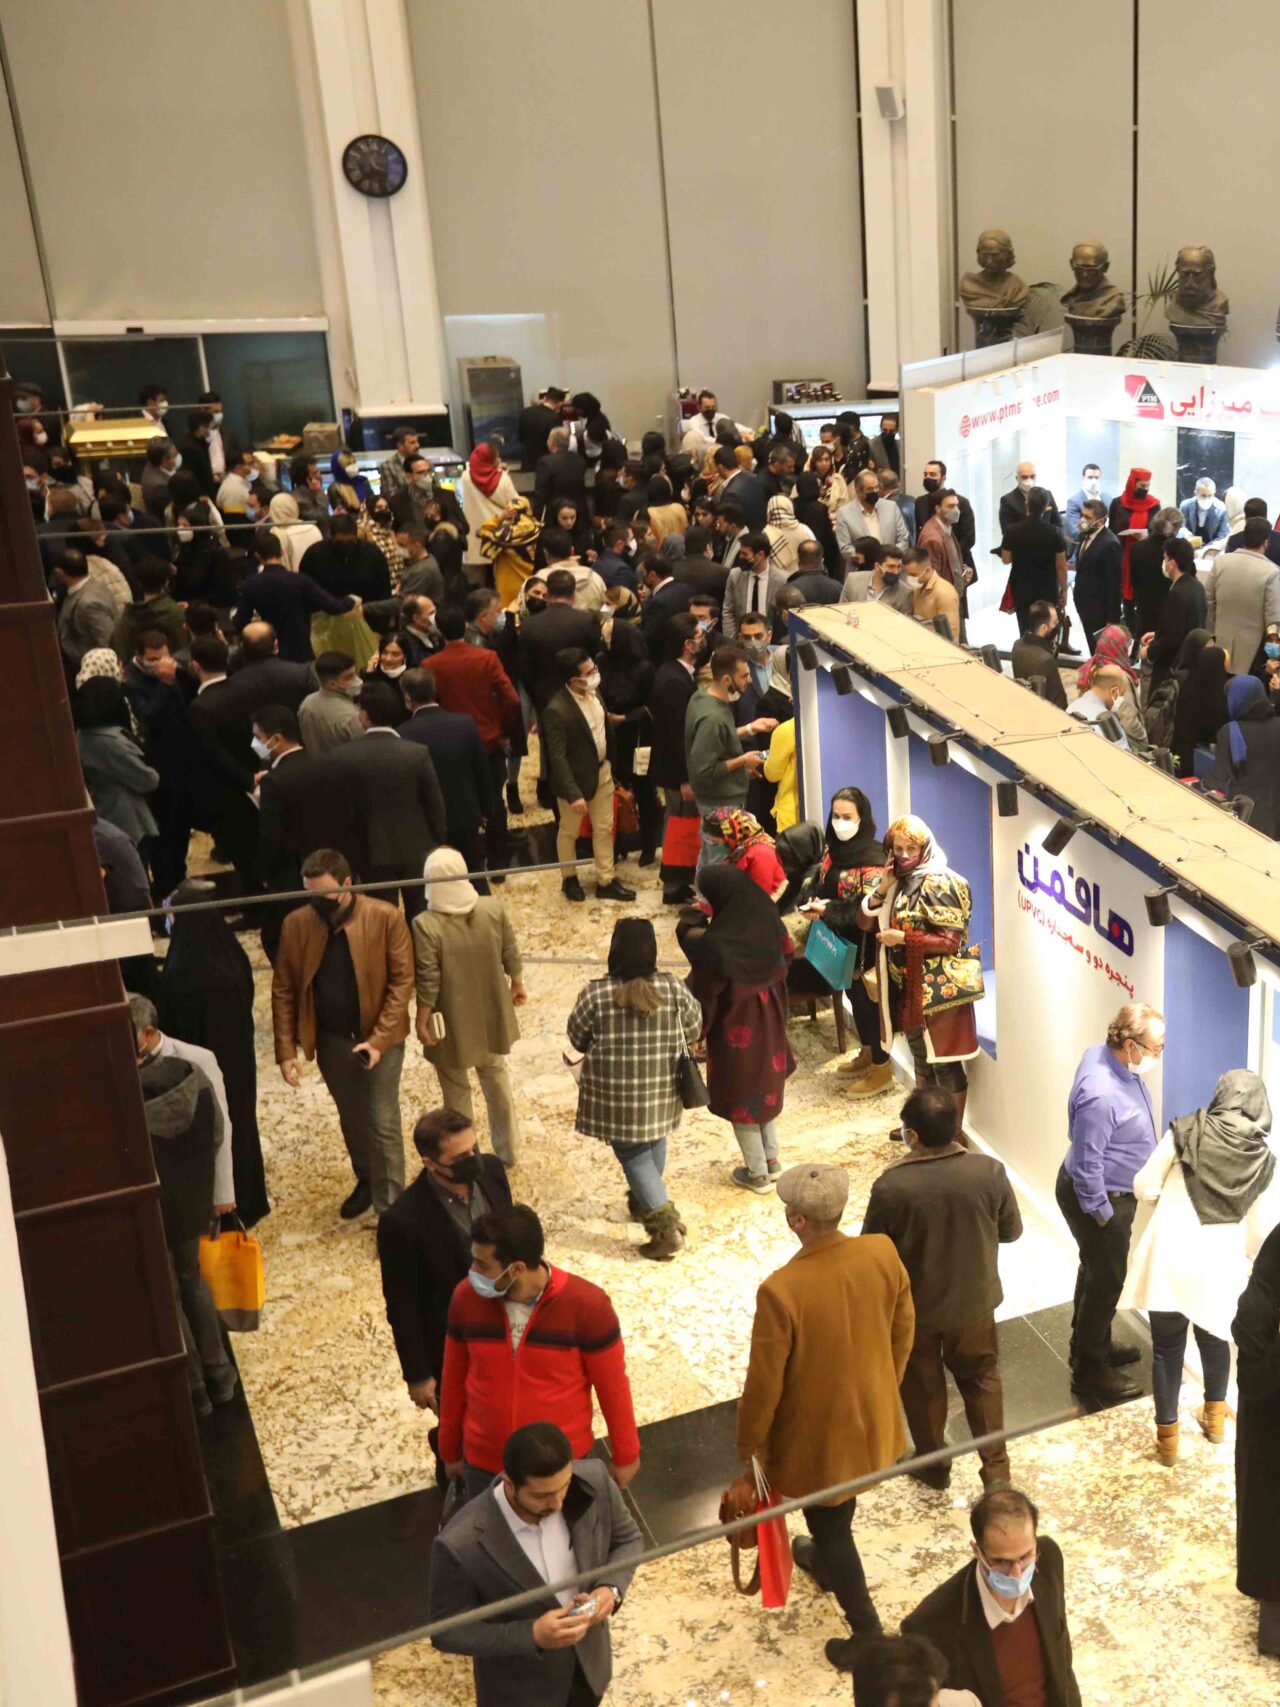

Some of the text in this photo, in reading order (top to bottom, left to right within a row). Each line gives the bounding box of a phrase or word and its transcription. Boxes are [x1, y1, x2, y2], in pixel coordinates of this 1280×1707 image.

[971, 388, 1060, 429] www.ptmse.com
[1017, 843, 1134, 958] هافمن
[1018, 889, 1045, 927] (UPVC)
[1105, 962, 1134, 999] پنجره
